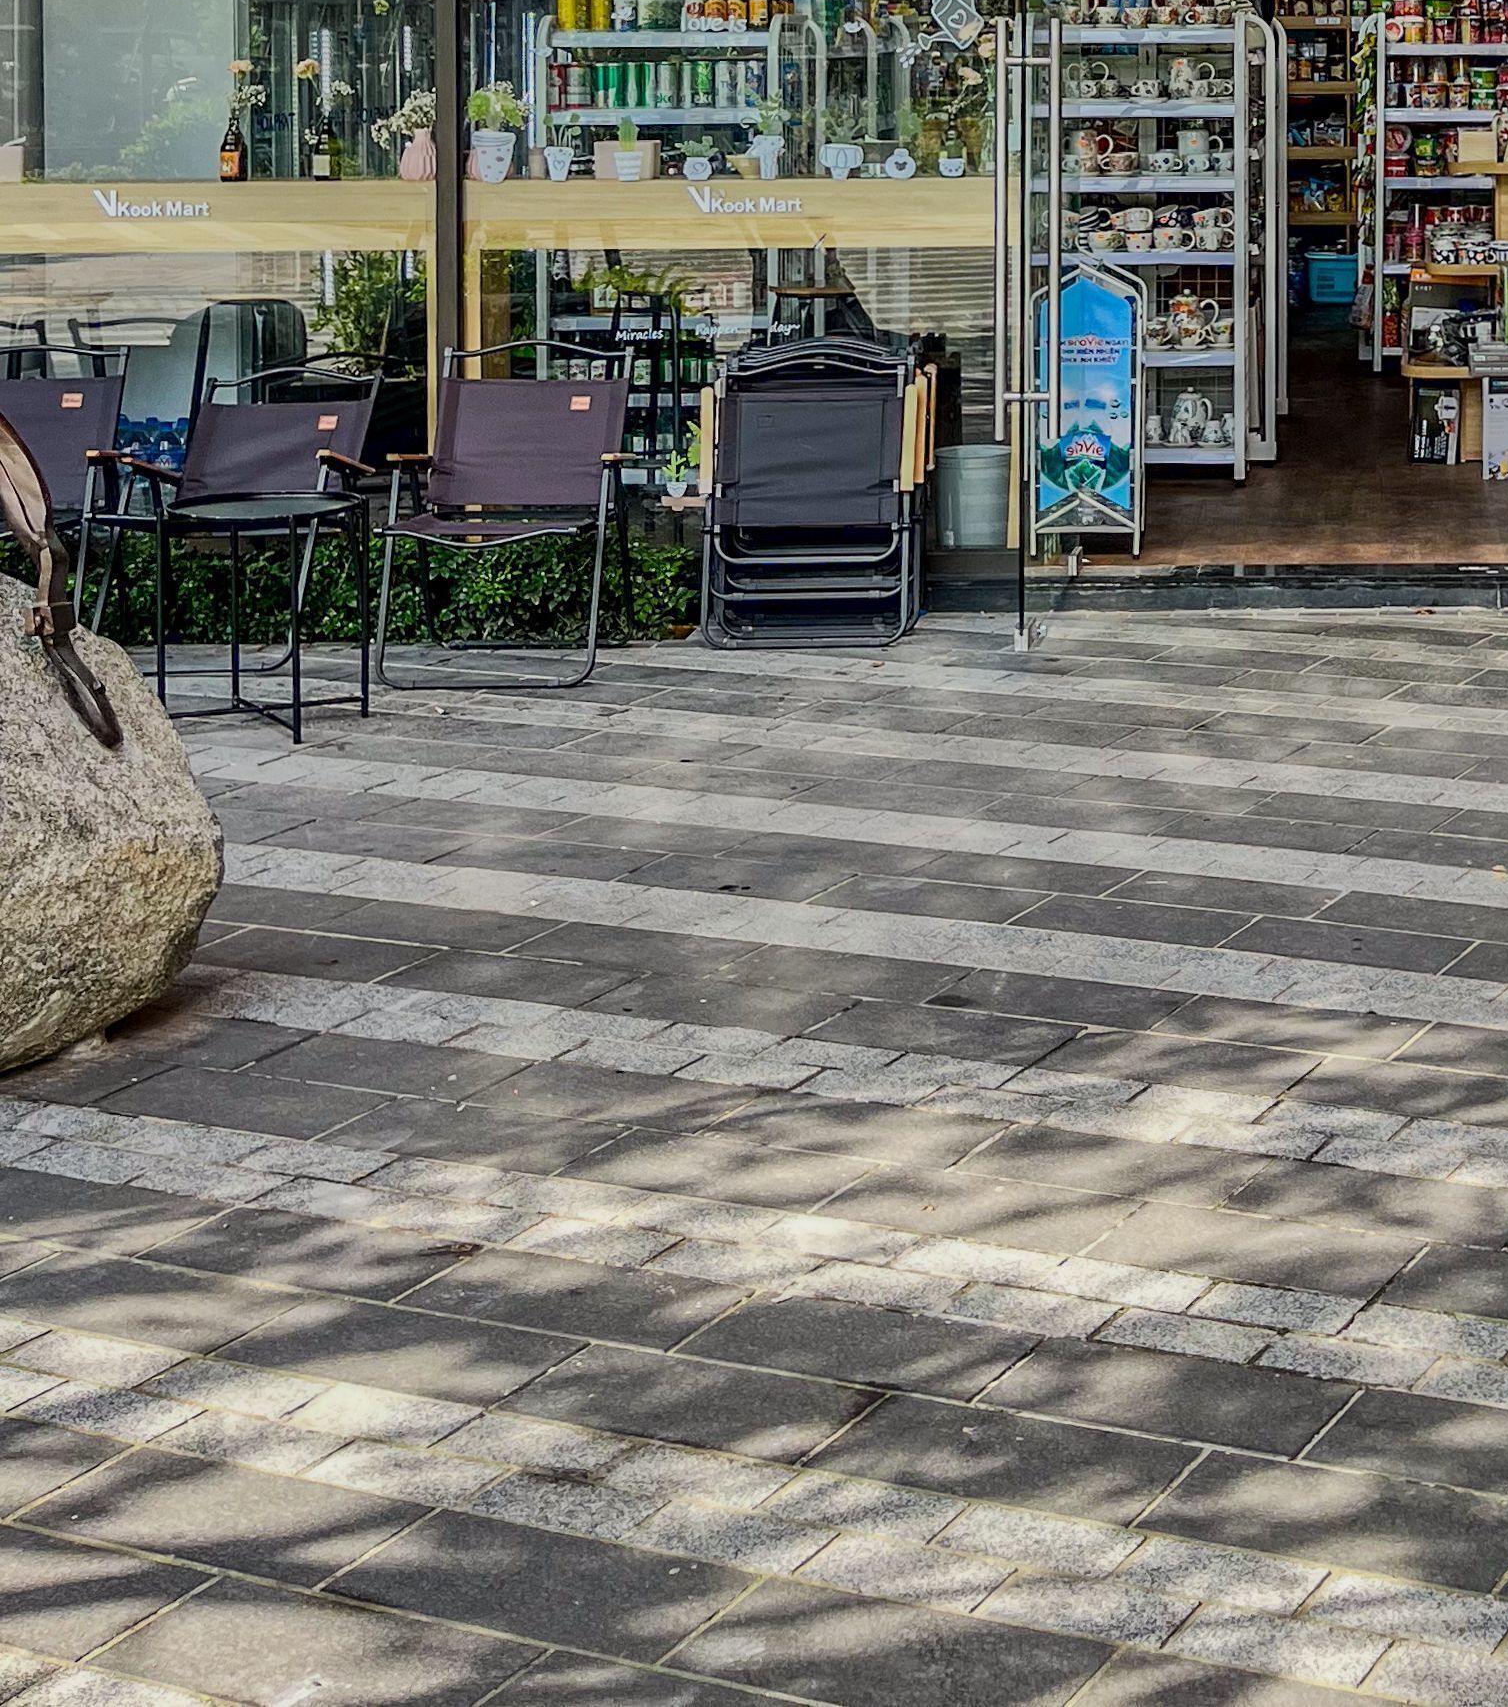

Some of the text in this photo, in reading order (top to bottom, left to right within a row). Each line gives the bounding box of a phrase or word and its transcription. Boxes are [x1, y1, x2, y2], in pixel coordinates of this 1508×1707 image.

[165, 200, 209, 217] Mart
[759, 196, 802, 213] Mart
[615, 327, 665, 341] Miracles
